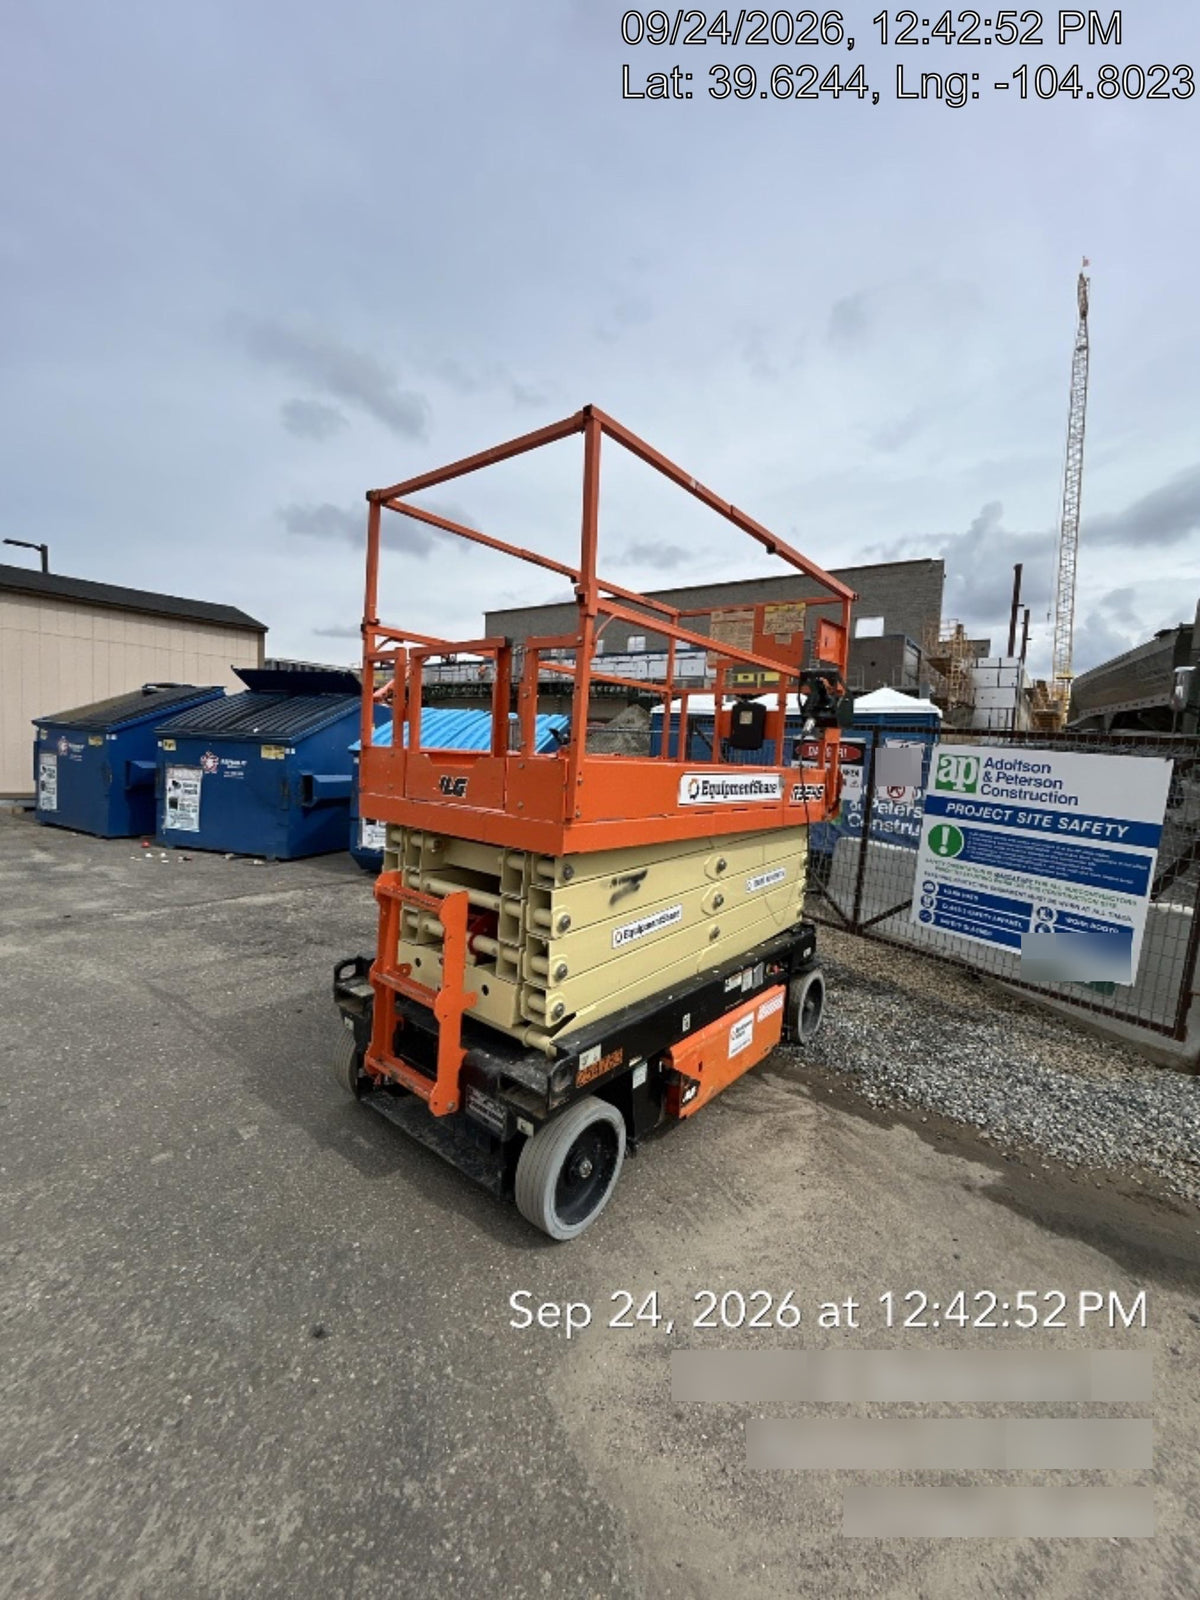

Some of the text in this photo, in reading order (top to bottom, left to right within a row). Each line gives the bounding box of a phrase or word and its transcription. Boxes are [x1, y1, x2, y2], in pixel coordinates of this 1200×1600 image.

[983, 757, 1052, 774] Adolfson
[701, 779, 778, 798] EquipmentShare
[982, 771, 1063, 790] & Peterson
[981, 784, 1079, 806] Construction
[946, 803, 1130, 839] PROJECT SITE SAFETY
